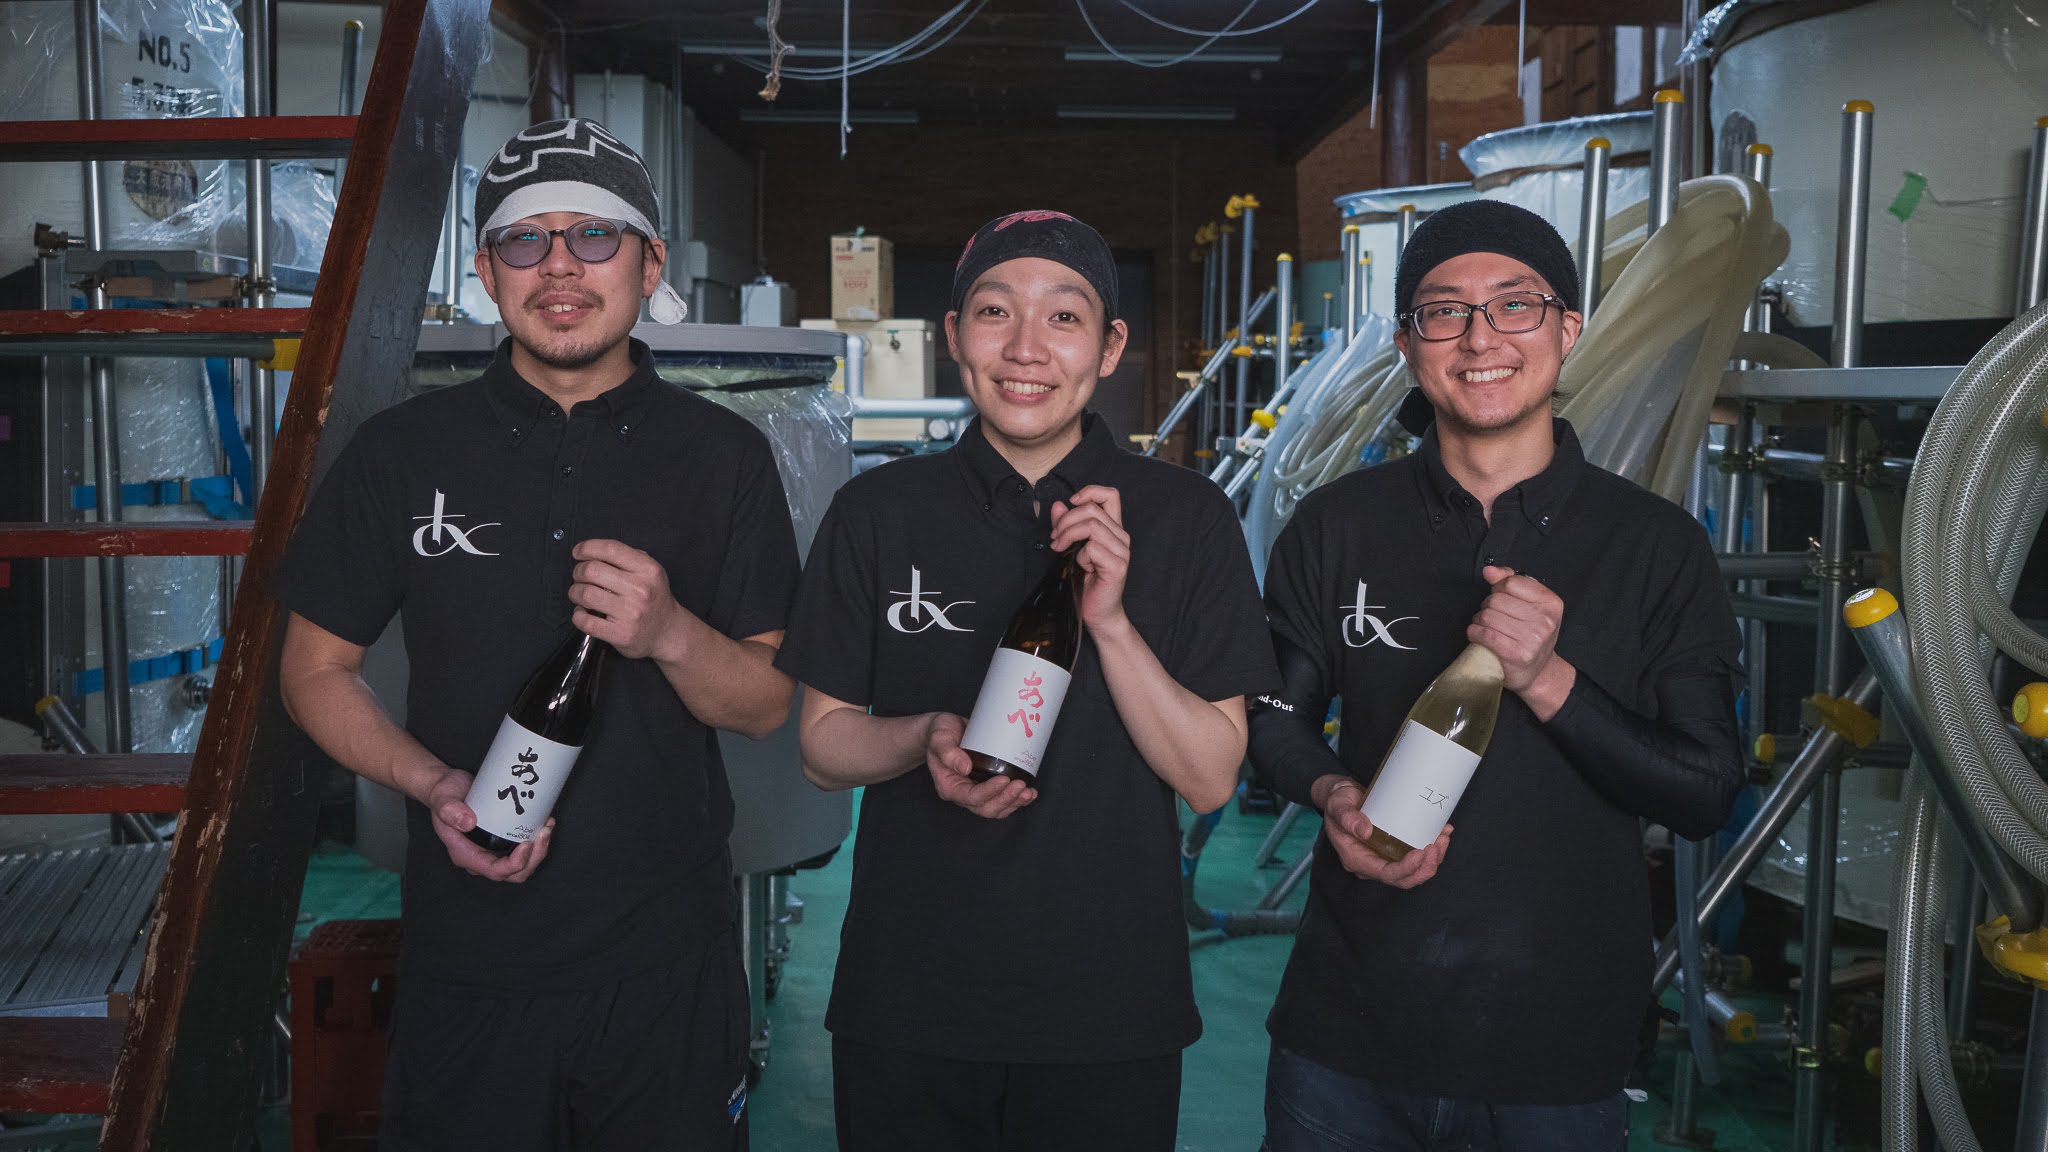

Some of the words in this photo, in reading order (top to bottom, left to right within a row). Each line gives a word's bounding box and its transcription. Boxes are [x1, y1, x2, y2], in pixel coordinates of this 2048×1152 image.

[138, 31, 190, 74] NO.5
[1007, 671, 1044, 738] あべ
[497, 746, 540, 815] あべ
[1419, 786, 1450, 810] ユズ
